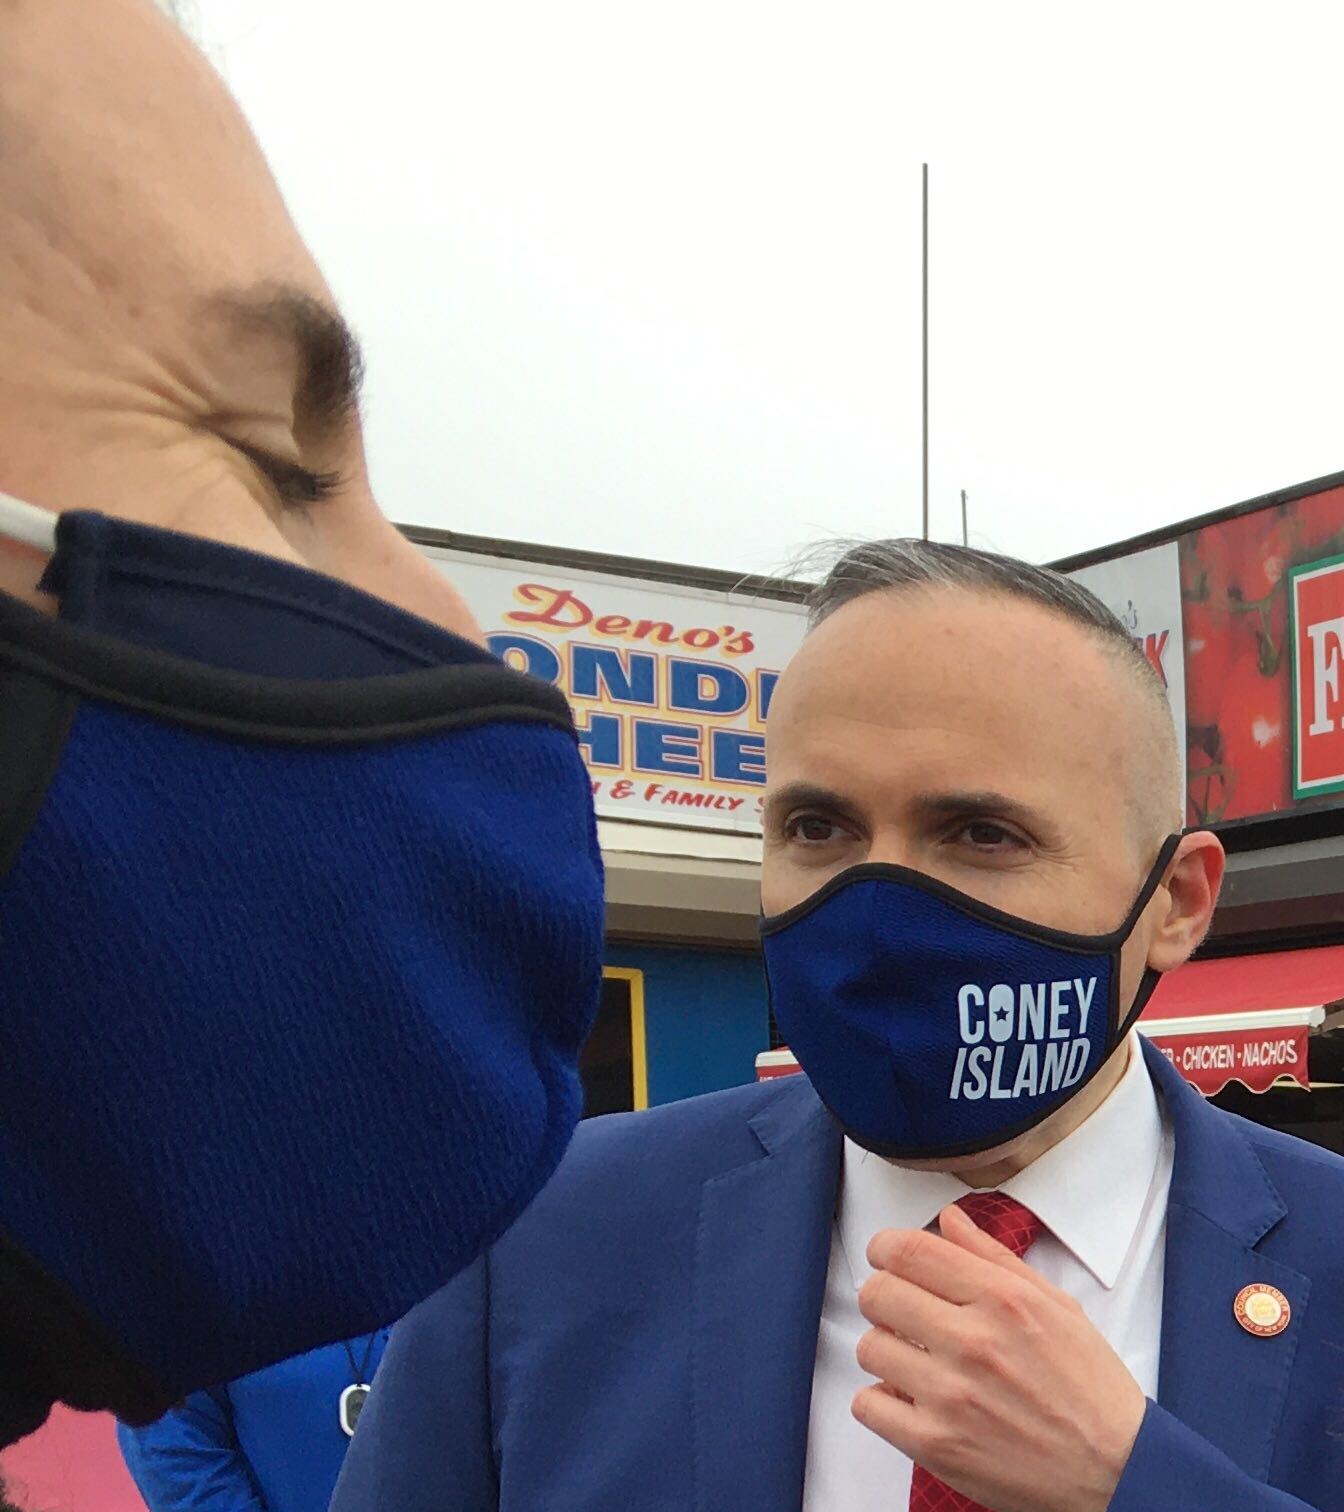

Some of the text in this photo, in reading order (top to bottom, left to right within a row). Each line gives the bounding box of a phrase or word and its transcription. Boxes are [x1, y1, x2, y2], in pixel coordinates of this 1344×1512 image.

[506, 582, 756, 656] Deno's
[644, 783, 745, 811] FAMILY
[958, 976, 1097, 1045] CONEY
[948, 1035, 1092, 1101] ISLAND
[1182, 1043, 1235, 1071] CHICKEN
[1242, 1039, 1298, 1067] NACHOS
